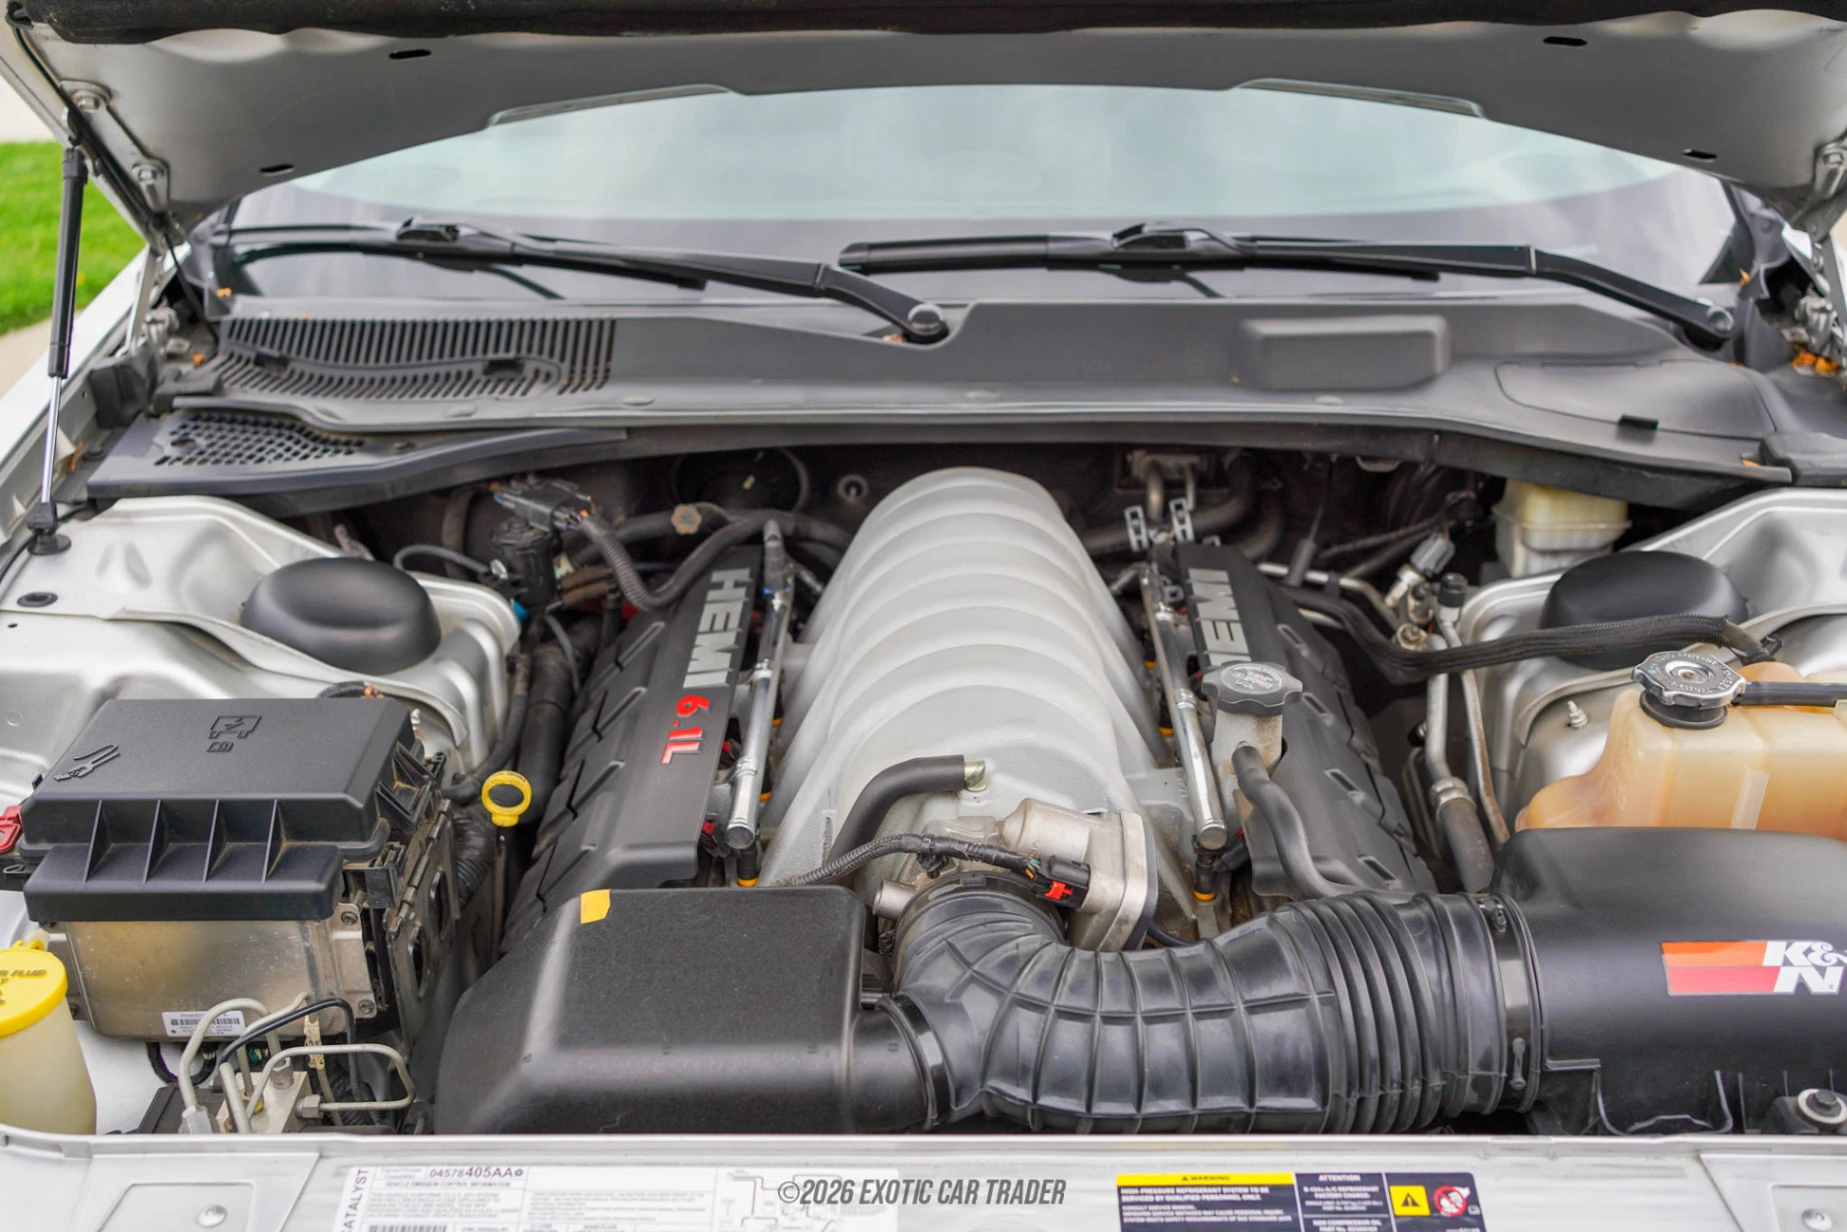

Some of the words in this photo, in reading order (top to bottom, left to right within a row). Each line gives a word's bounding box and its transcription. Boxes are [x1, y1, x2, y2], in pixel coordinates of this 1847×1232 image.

[683, 568, 751, 688] HEMI
[662, 694, 710, 764] 6.1L
[11, 969, 47, 977] FLUID
[1762, 941, 1847, 993] K&N
[430, 1167, 513, 1177] 04578405AA
[1319, 1174, 1361, 1182] ATTENTION
[341, 1168, 369, 1232] ATALYST
